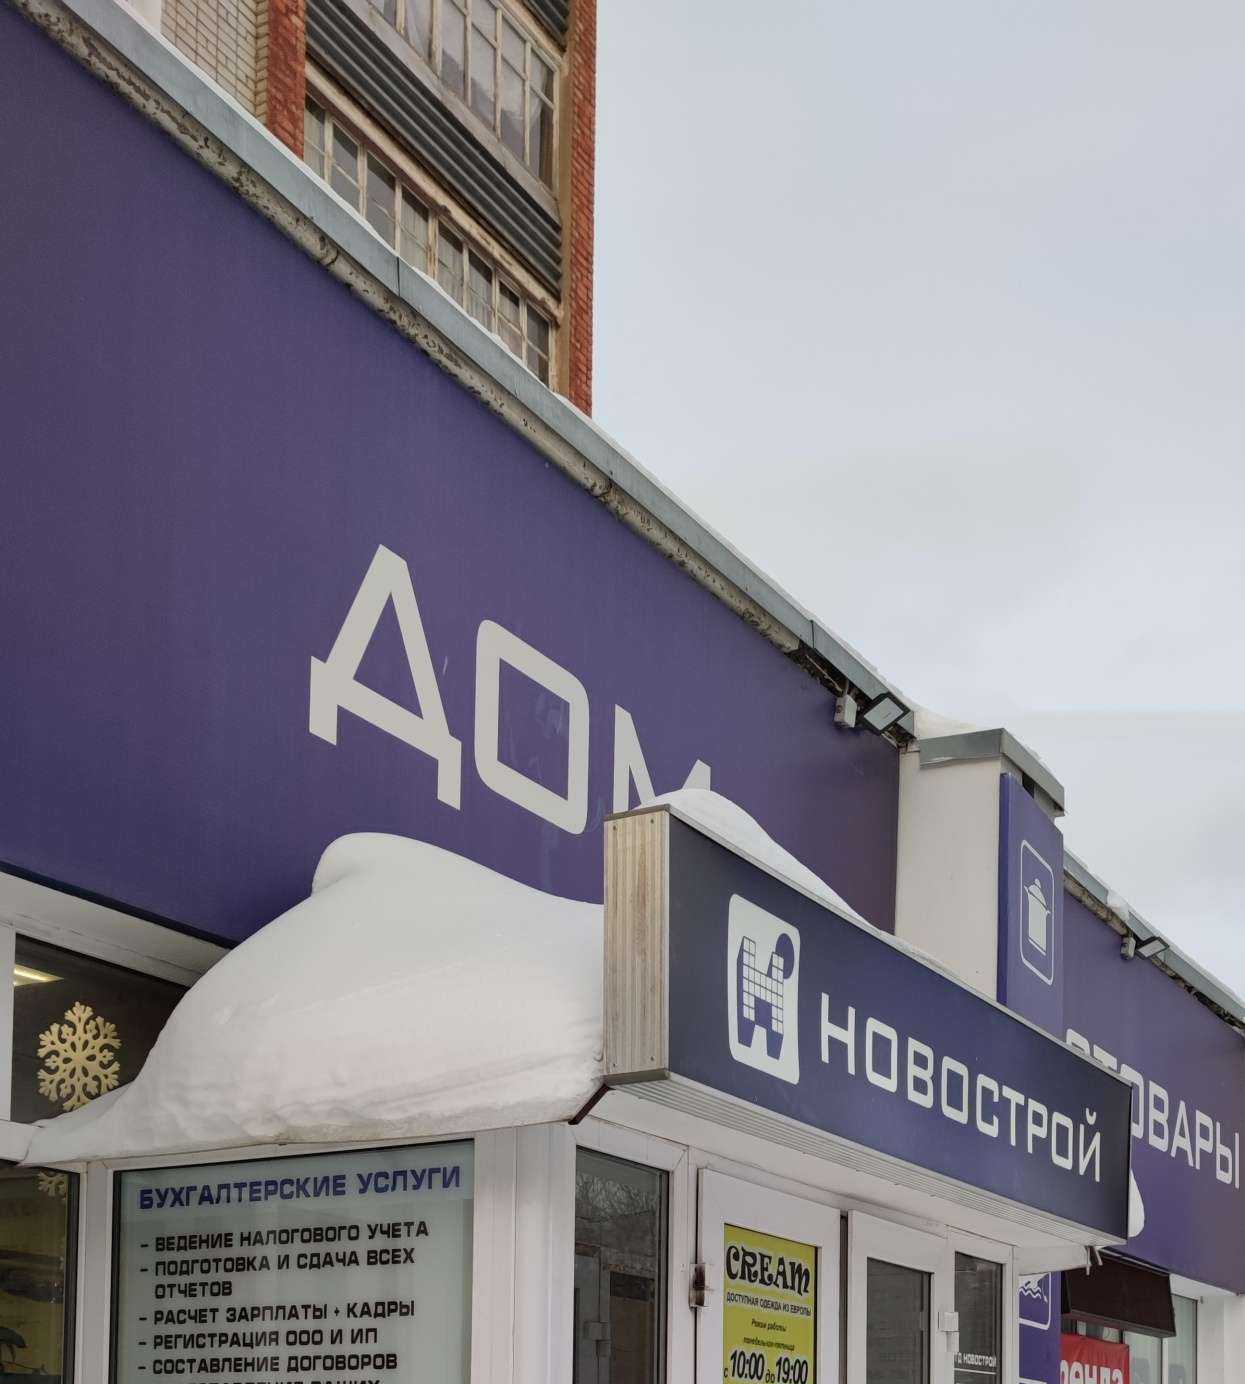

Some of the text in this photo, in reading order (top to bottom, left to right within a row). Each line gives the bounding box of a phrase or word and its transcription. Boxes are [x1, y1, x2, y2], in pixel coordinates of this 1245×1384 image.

[821, 992, 1101, 1183] НОВОСТРОЙ
[139, 1166, 461, 1209] БУХГАЛТЕРСКИЕ УСЛУГИ
[155, 1232, 234, 1252] ВЕДЕНИЕ
[239, 1224, 360, 1247] НАЛОГОВОГО
[367, 1221, 429, 1240] УЧЕТА
[155, 1255, 271, 1277] ПОДГОТОВКА
[277, 1254, 290, 1270] И
[296, 1251, 360, 1270] СДАЧА
[366, 1248, 415, 1265] ВСЕХ
[725, 1245, 811, 1296] CREAM
[154, 1281, 233, 1299] ОТЧЕТОВ
[726, 1291, 759, 1307] ДОСТУПНАЯ
[759, 1298, 782, 1312] ОДЕЖДА
[790, 1303, 811, 1317] ЕВРОПЫ
[153, 1307, 219, 1325] РАСЧЕТ
[226, 1303, 328, 1323] ЗАРПЛАТЫ
[346, 1301, 415, 1319] КАДРЫ
[153, 1331, 279, 1350] РЕГИСТРАЦИЯ
[285, 1330, 323, 1346] ООО
[330, 1329, 343, 1344] И
[351, 1328, 378, 1344] ИП
[152, 1356, 280, 1375] СОСТАВЛЕНИЕ
[286, 1353, 397, 1373] ДОГОВОРОВ
[729, 1350, 765, 1380] 10:00
[765, 1370, 775, 1384] до
